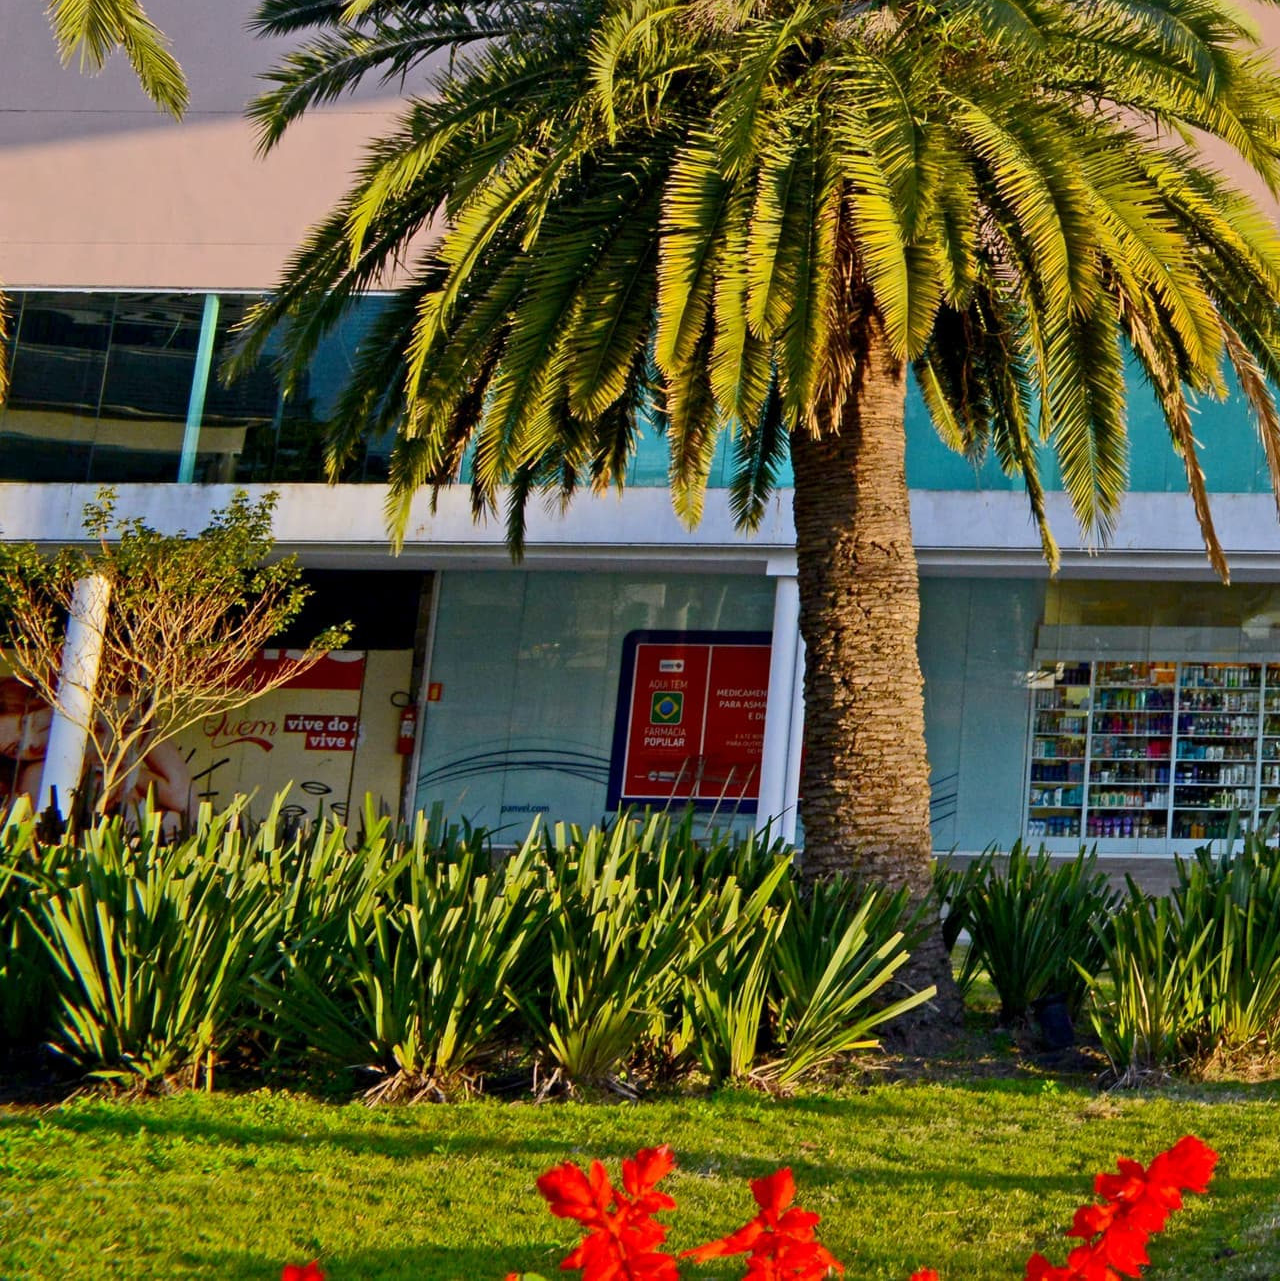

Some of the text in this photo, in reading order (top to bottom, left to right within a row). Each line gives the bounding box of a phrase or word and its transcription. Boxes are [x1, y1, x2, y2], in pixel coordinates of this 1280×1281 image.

[648, 680, 688, 689] AQUI TEM
[719, 700, 741, 708] PARA
[288, 716, 324, 730] vive
[328, 717, 349, 731] do
[204, 712, 278, 749] Quem
[310, 733, 346, 747] vive
[644, 737, 685, 747] POPULAR
[501, 803, 549, 814] panvel.com
